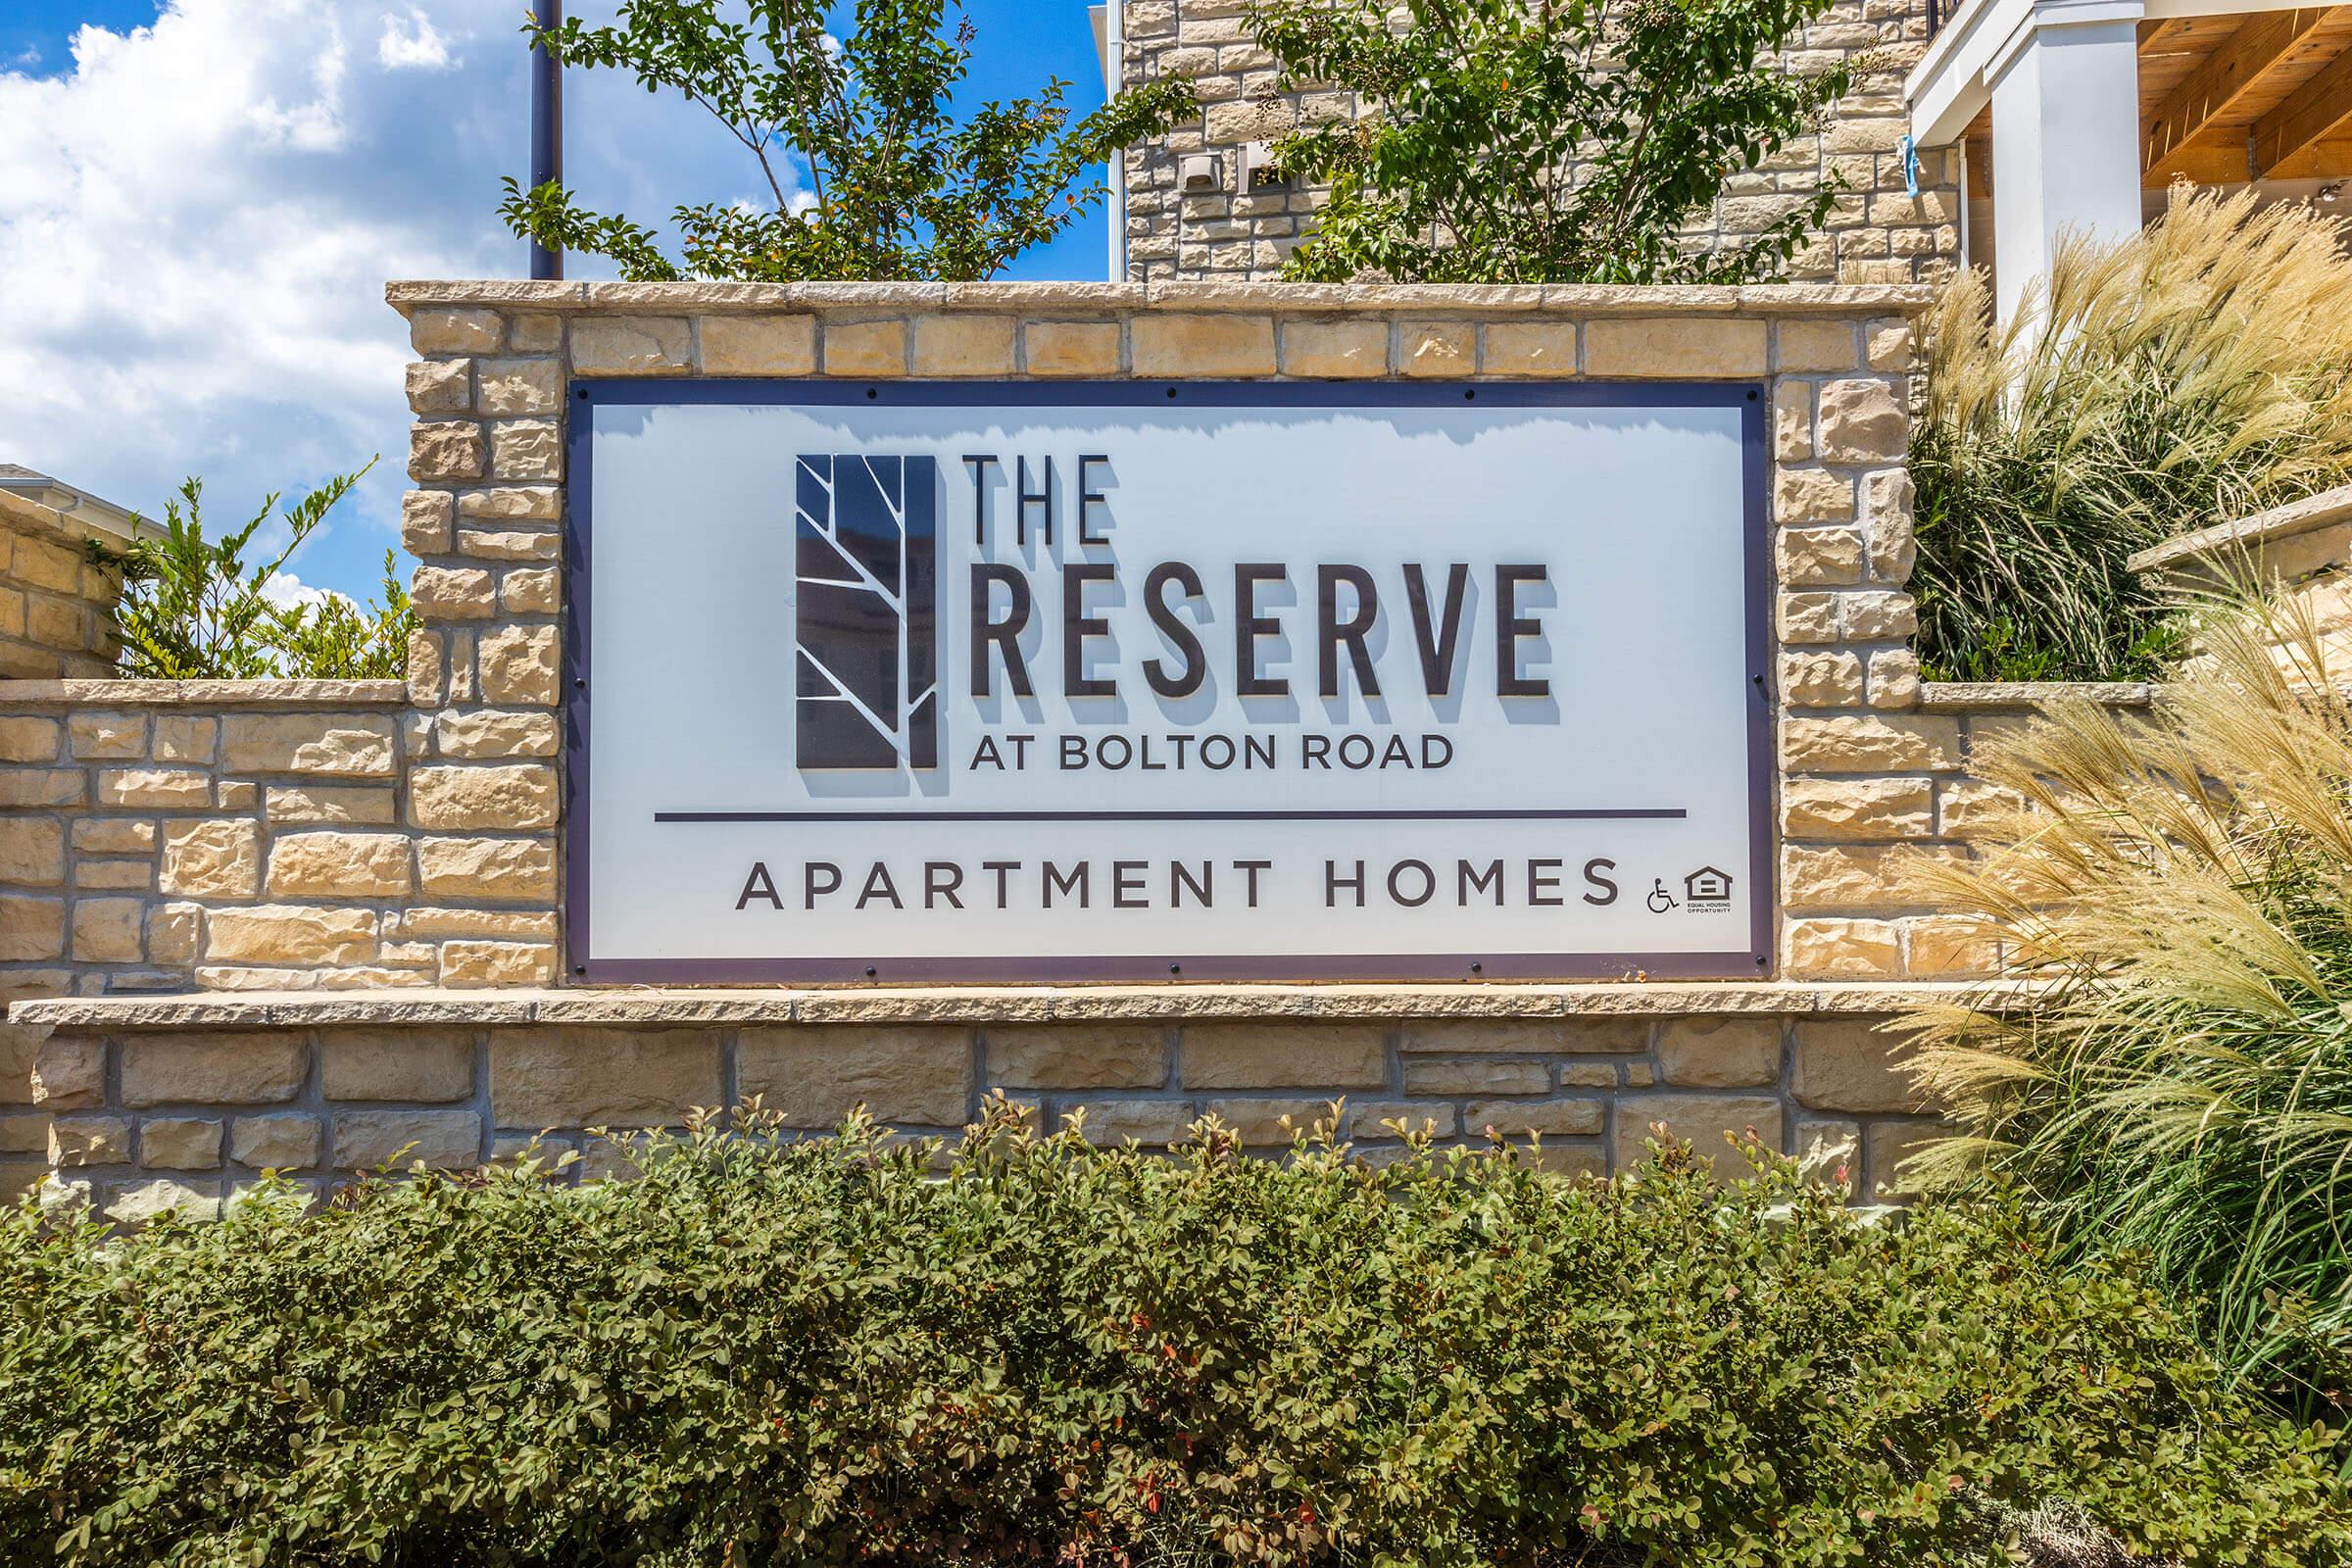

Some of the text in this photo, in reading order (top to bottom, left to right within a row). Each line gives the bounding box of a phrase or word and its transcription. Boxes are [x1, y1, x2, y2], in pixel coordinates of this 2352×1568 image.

[962, 455, 1109, 545] THE
[970, 563, 1550, 699] RESERVE
[968, 734, 1453, 770] AT BOLTON ROAD
[735, 858, 1618, 910] APARTMENT HOMES
